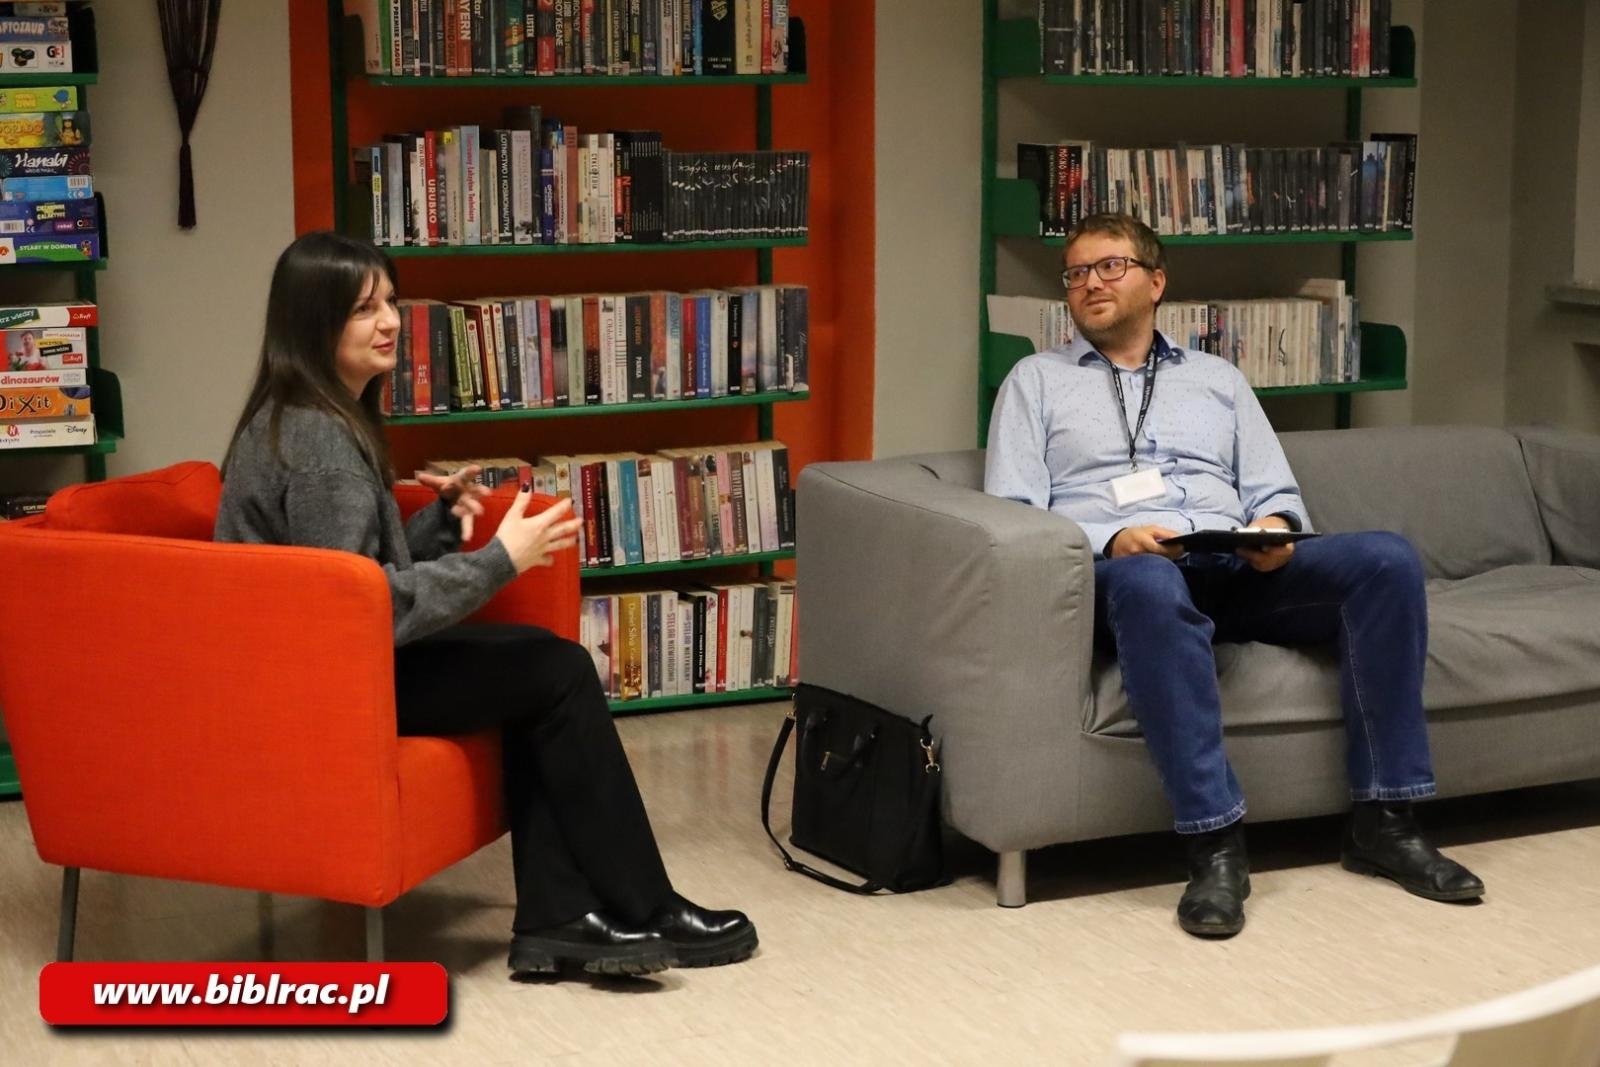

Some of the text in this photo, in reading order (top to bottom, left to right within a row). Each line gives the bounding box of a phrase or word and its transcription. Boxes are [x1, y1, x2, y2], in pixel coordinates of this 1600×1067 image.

[555, 17, 563, 46] KEANE
[15, 152, 69, 168] Hanabi
[427, 178, 437, 224] URUBKO
[635, 355, 643, 379] PANIKA
[1, 375, 60, 385] dinozaurów
[64, 424, 87, 434] Disney
[627, 626, 636, 646] Silva
